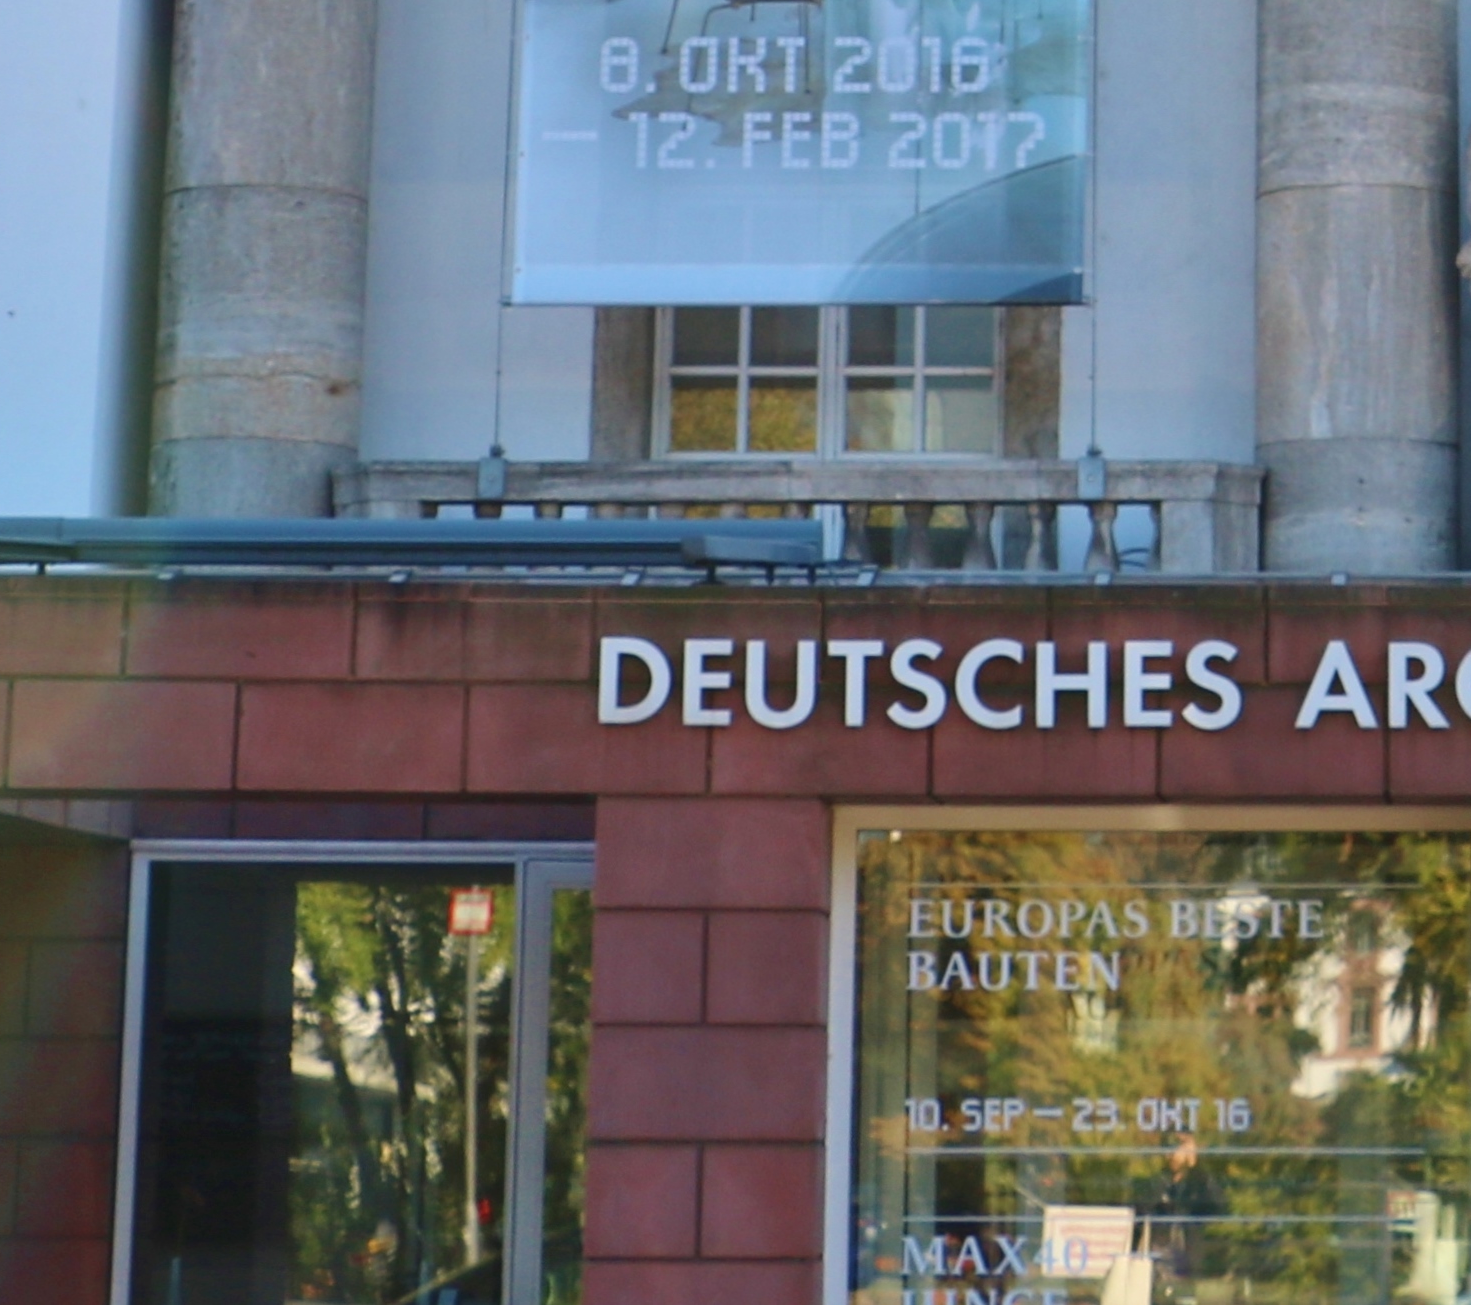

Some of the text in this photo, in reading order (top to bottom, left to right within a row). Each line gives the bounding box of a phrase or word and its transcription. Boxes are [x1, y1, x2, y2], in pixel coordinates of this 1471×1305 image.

[599, 36, 989, 94] 8. OKT 2016
[629, 111, 716, 169] 12.
[742, 111, 859, 169] FEB
[887, 111, 1046, 169] 2017
[596, 634, 1242, 731] DEUTSCHES
[906, 897, 1325, 940] EUROPAS BESTE
[905, 949, 1122, 990] BAUTEN
[905, 1098, 949, 1132] 10.
[960, 1098, 1026, 1132] SEP
[1071, 1098, 1127, 1132] 23.
[1137, 1098, 1202, 1132] OKT
[1215, 1098, 1252, 1132] 16
